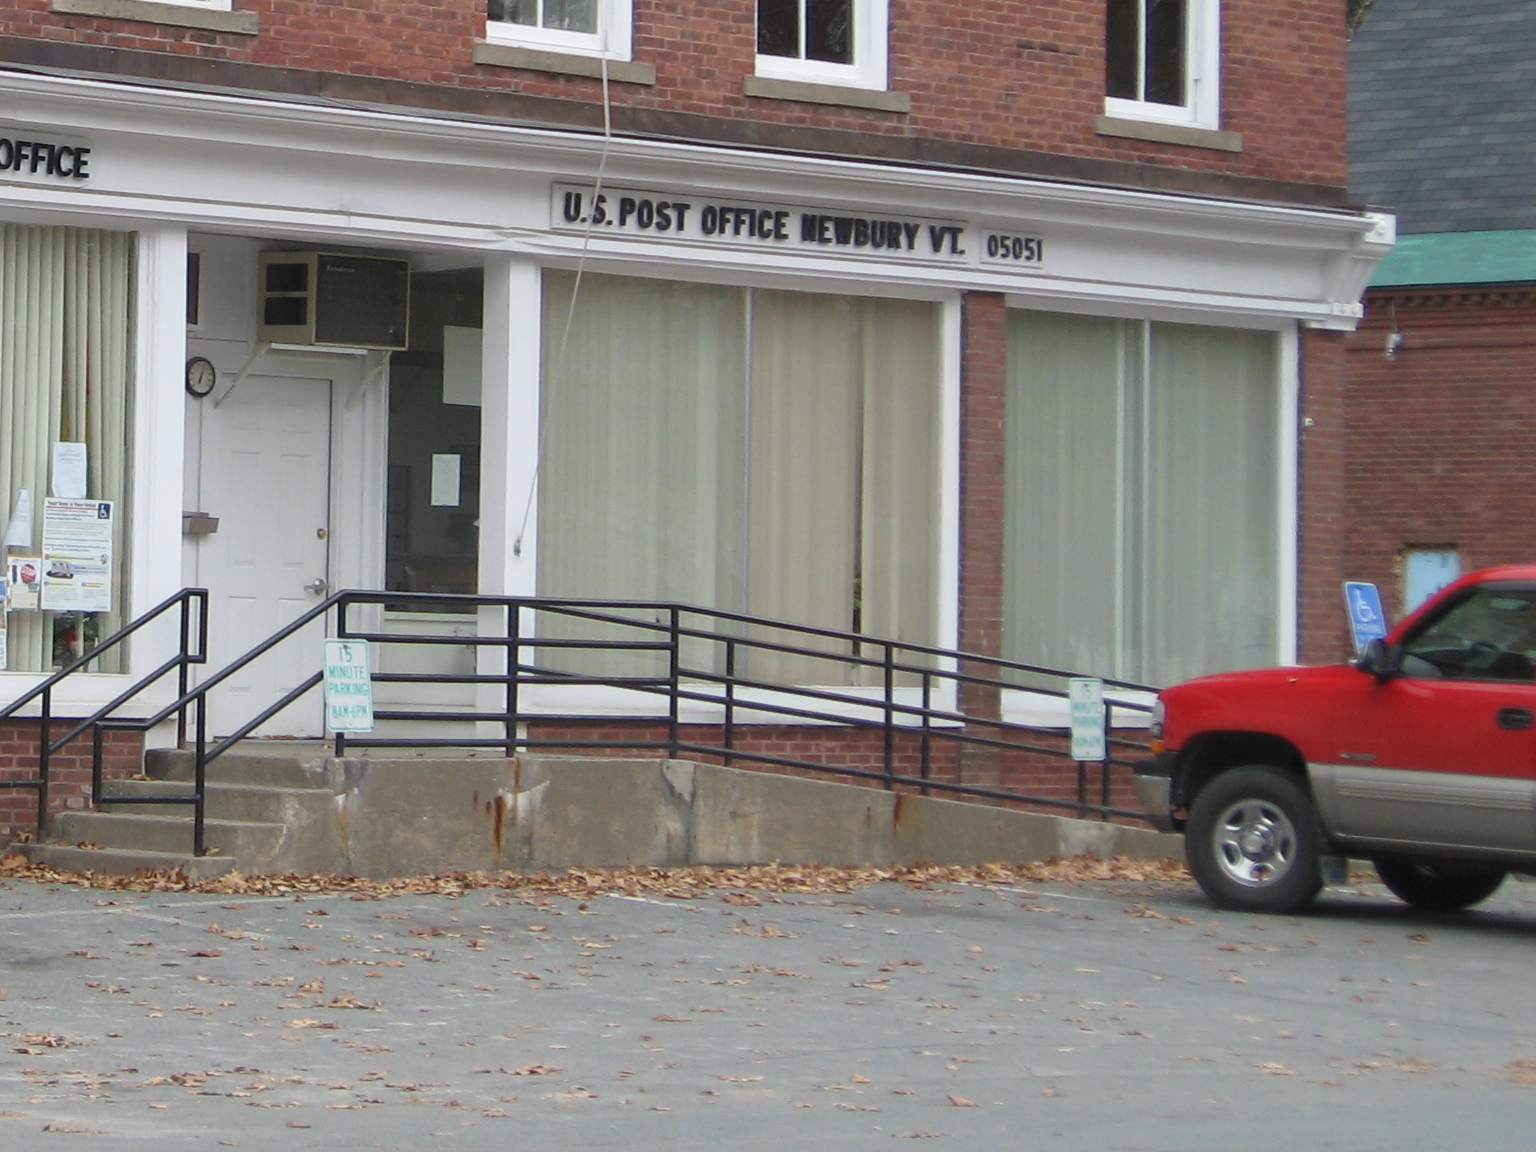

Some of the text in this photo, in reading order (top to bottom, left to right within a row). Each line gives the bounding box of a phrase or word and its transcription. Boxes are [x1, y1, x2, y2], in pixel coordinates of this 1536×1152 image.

[564, 192, 966, 255] U.S. POST OFFICE NEWBURY VT.
[987, 234, 1043, 262] 05051
[339, 646, 352, 663] 15
[328, 665, 365, 679] MINUTE
[328, 682, 370, 696] PARKING
